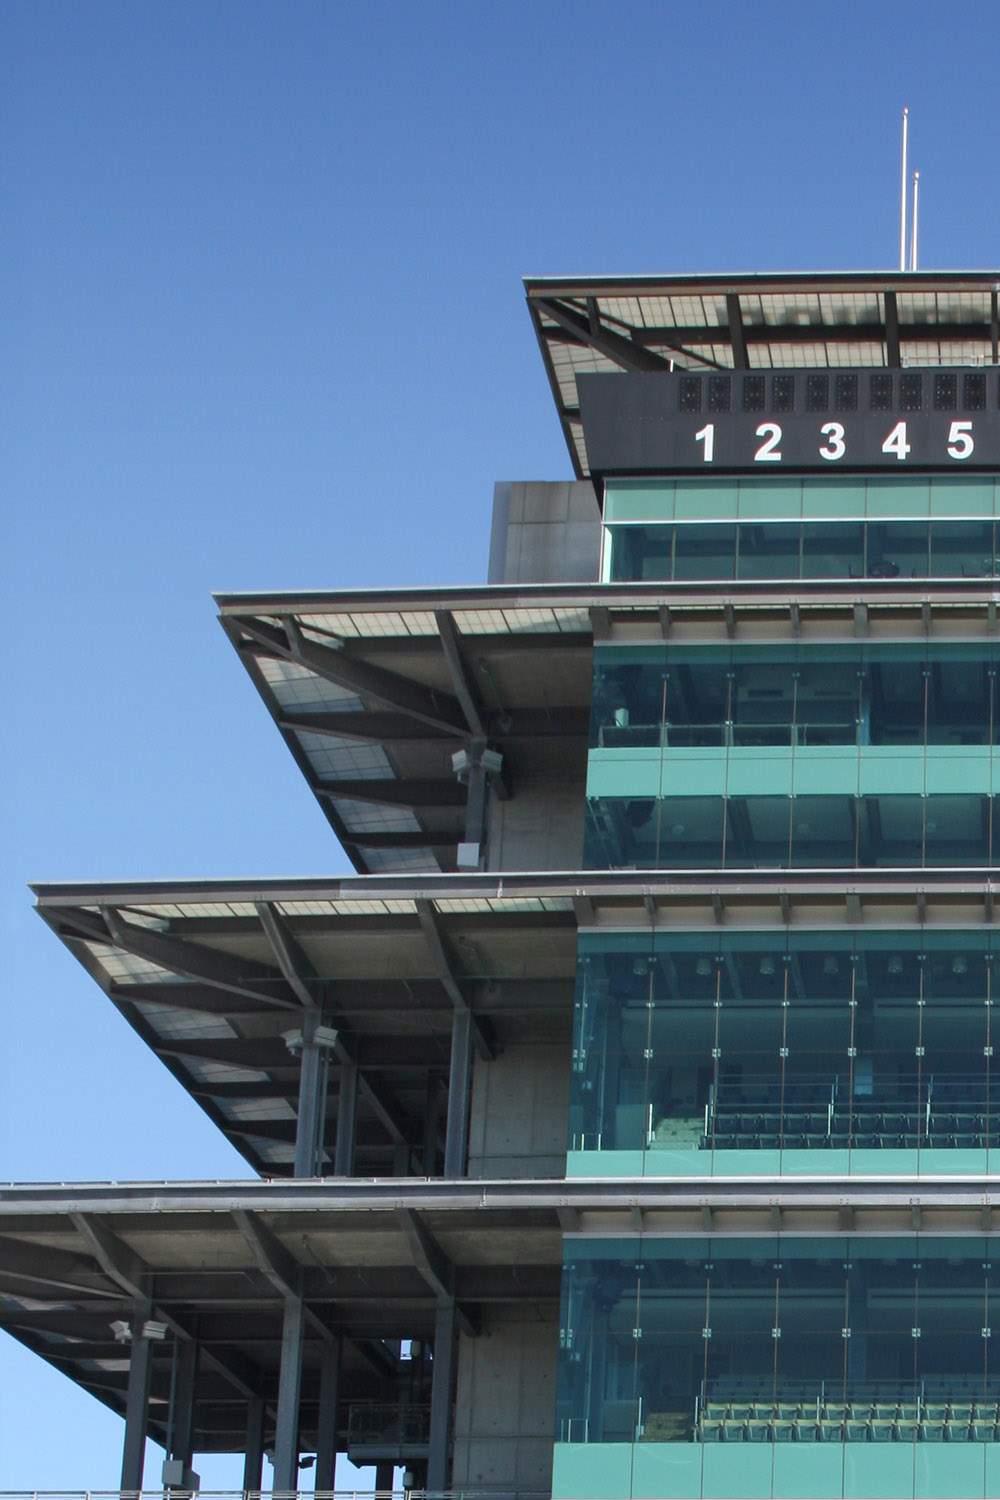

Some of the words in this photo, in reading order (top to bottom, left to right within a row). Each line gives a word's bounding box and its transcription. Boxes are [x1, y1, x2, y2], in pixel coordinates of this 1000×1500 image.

[694, 423, 716, 462] 1
[754, 423, 783, 462] 2
[819, 423, 846, 461] 3
[881, 422, 911, 460] 4
[946, 421, 975, 460] 5
